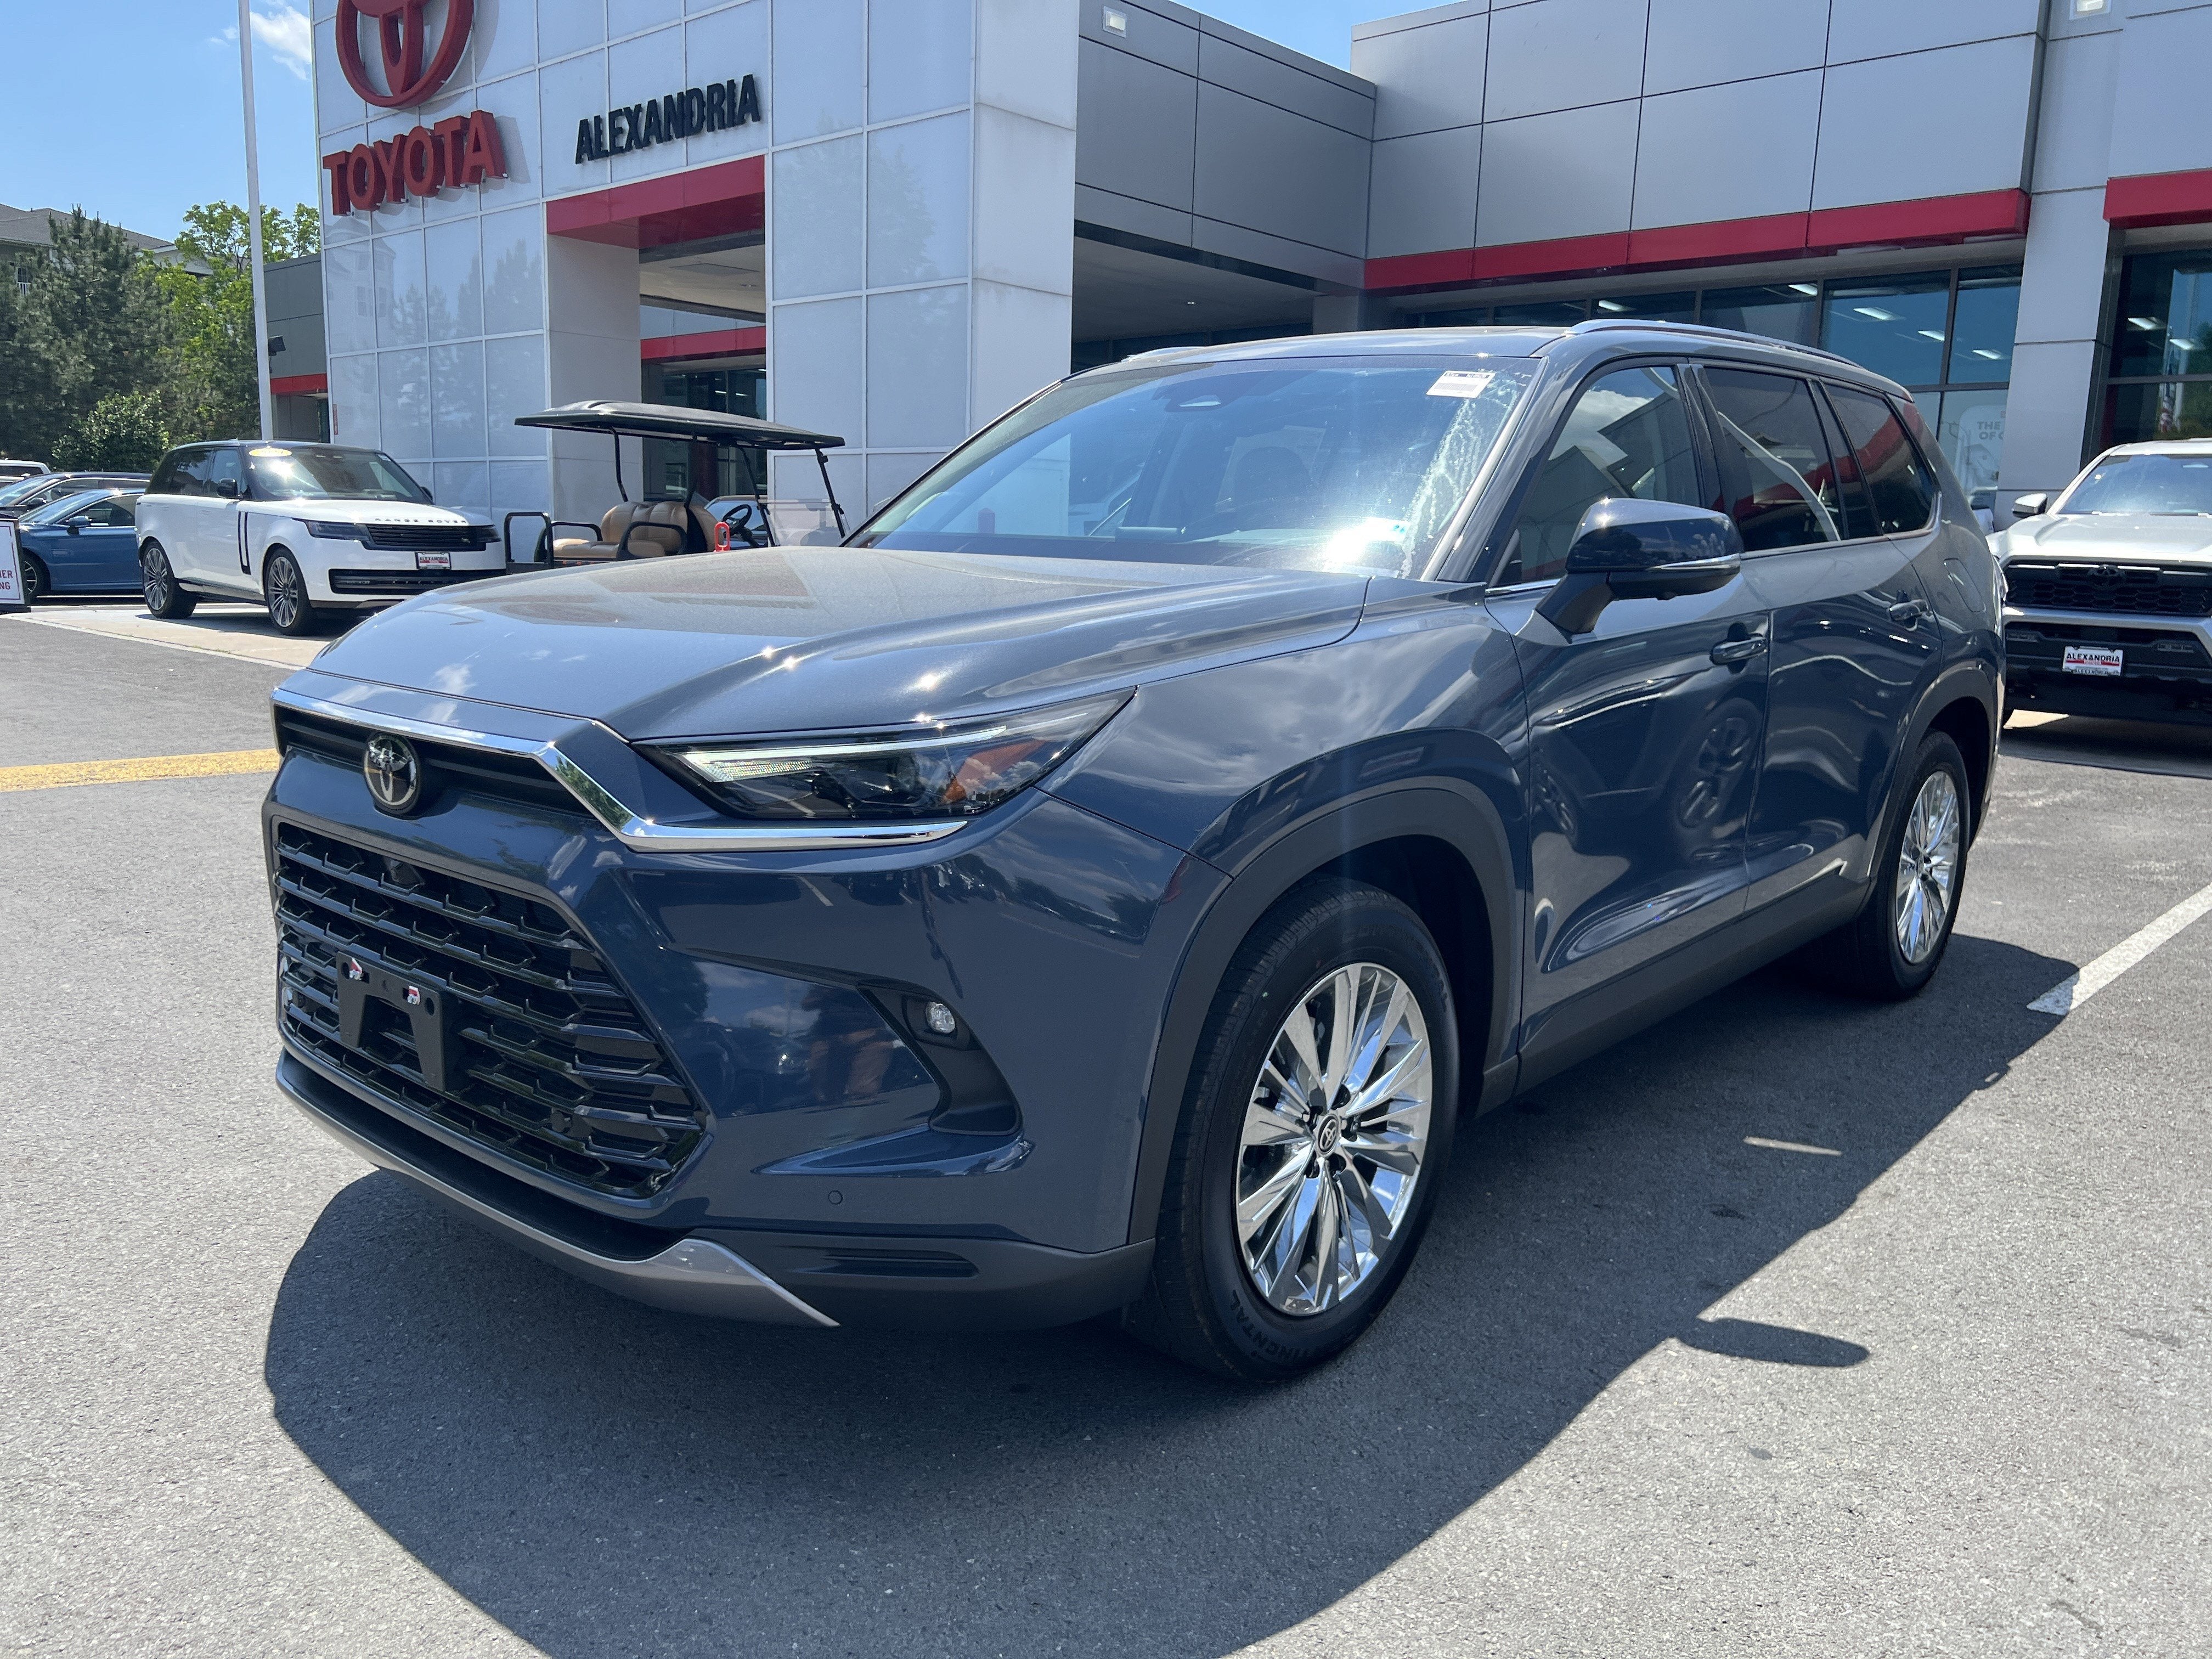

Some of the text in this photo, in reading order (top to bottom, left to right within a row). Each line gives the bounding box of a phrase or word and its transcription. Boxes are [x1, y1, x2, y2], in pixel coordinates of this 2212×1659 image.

[575, 74, 760, 164] ALEXANDRIA
[323, 110, 507, 216] TOYOTA
[1977, 421, 2001, 430] THE
[2066, 652, 2120, 662] ALEXANDRIA
